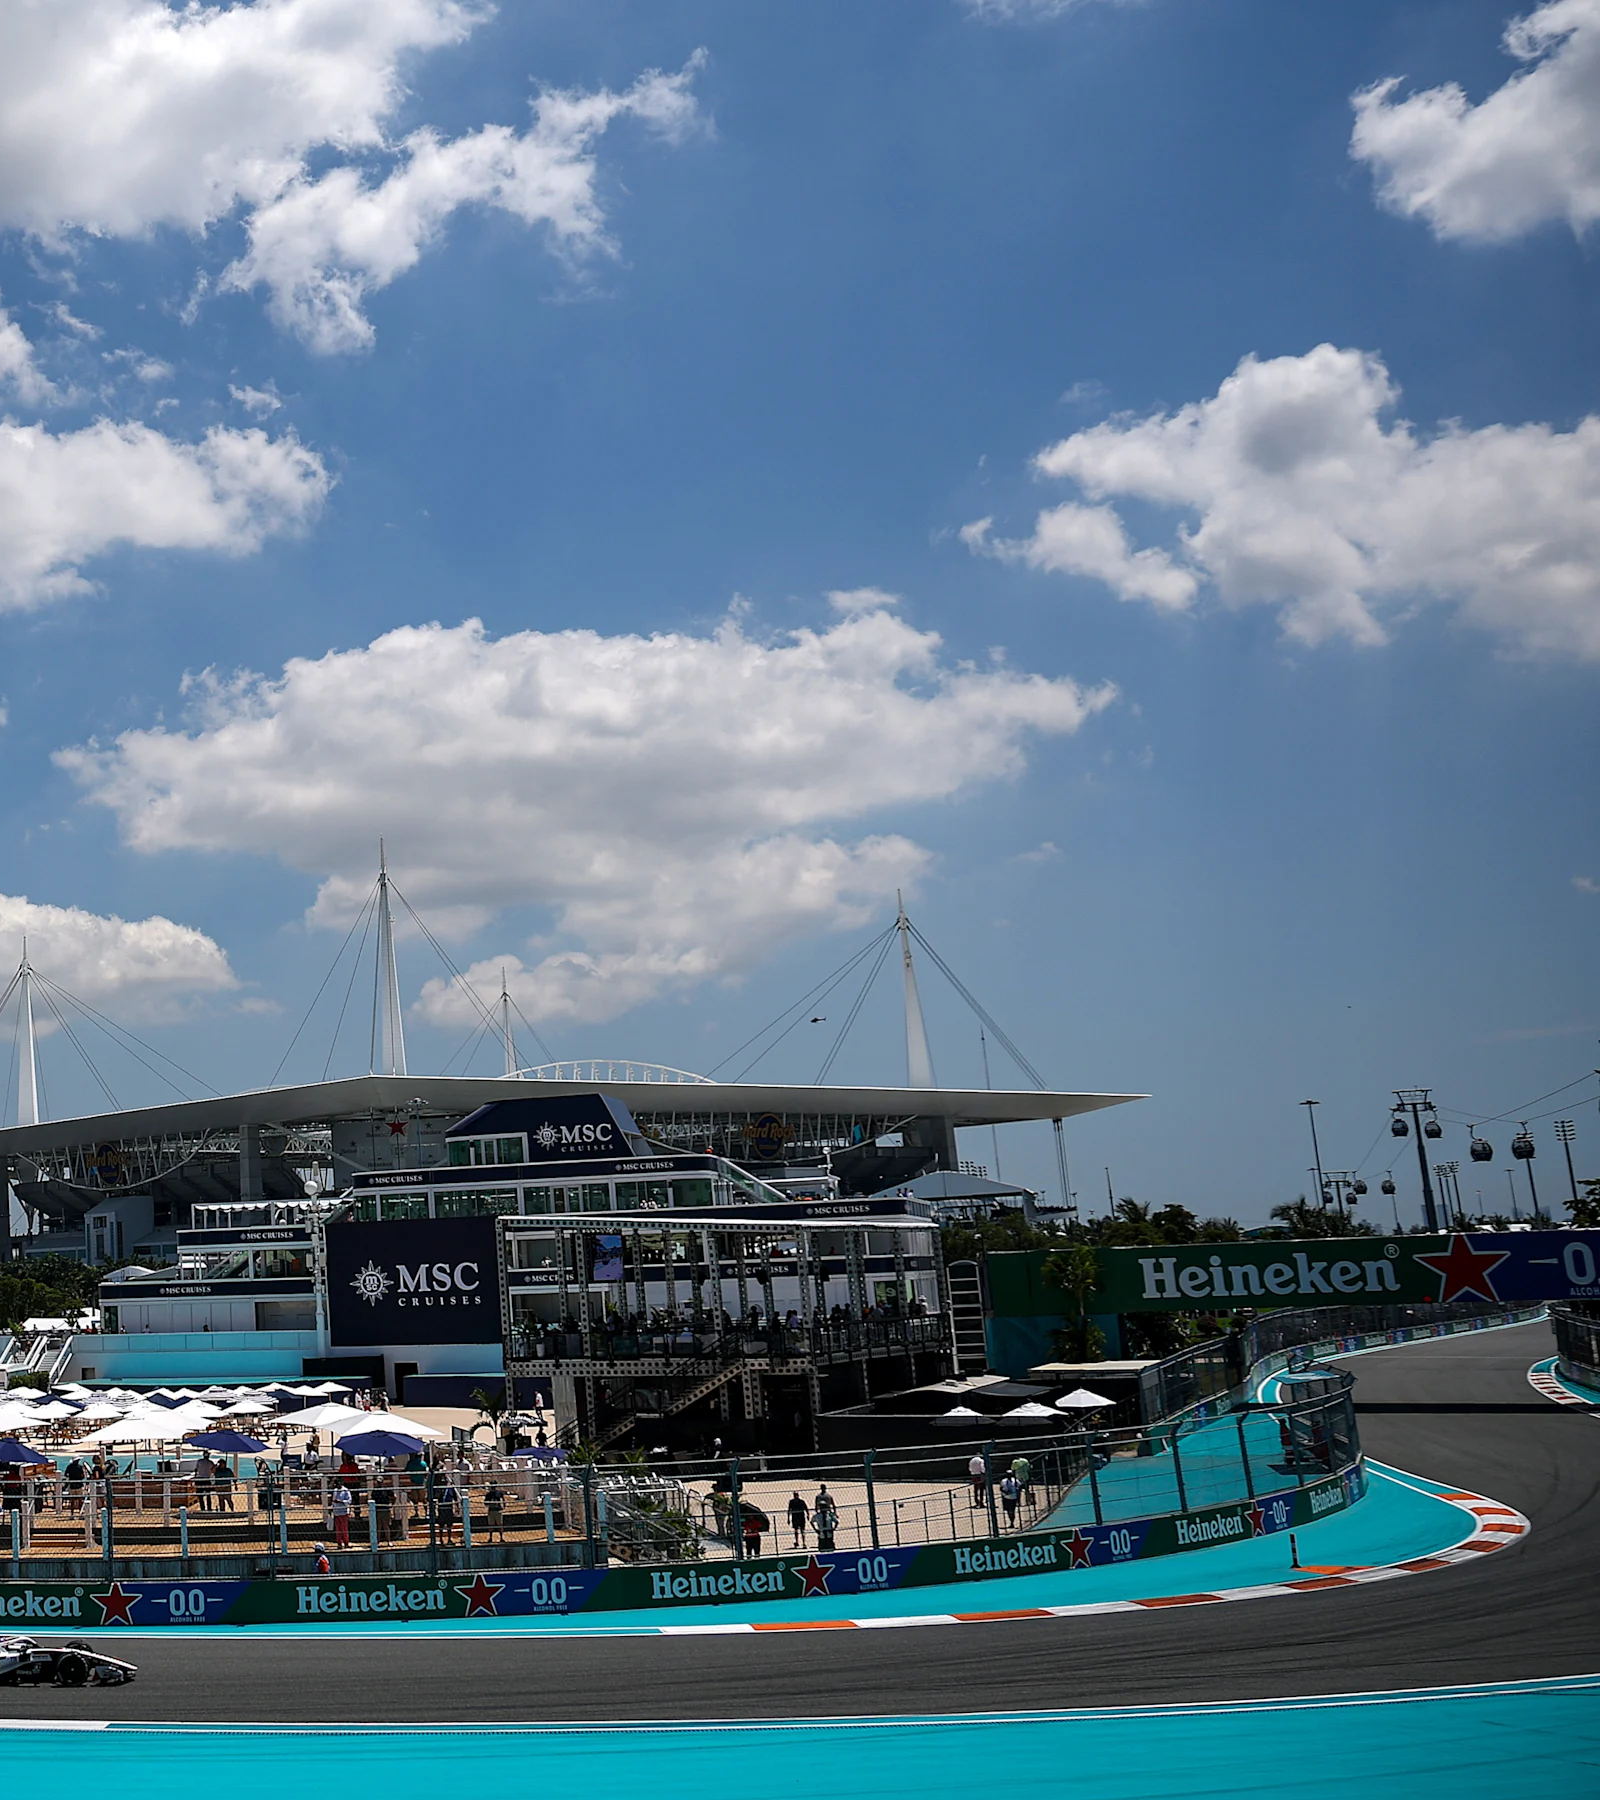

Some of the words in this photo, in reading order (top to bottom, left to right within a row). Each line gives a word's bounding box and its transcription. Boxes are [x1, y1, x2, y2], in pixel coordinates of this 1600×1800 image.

[560, 1123, 613, 1144] MSC
[561, 1144, 614, 1153] CRUISES
[623, 1162, 639, 1171] MSC
[640, 1161, 674, 1170] CRUISES
[375, 1176, 390, 1184] MSC
[391, 1175, 423, 1183] CRUISES
[247, 1232, 261, 1240] MSC
[262, 1231, 294, 1239] CRUISES
[395, 1262, 480, 1292] MSC
[1138, 1253, 1401, 1299] Heineken
[181, 1286, 211, 1294] CRUISES
[398, 1296, 481, 1307] CRUISES
[1175, 1513, 1244, 1545] Heineken
[953, 1542, 1057, 1575] Heineken
[650, 1568, 785, 1599] Heineken
[296, 1584, 447, 1614] Heineken
